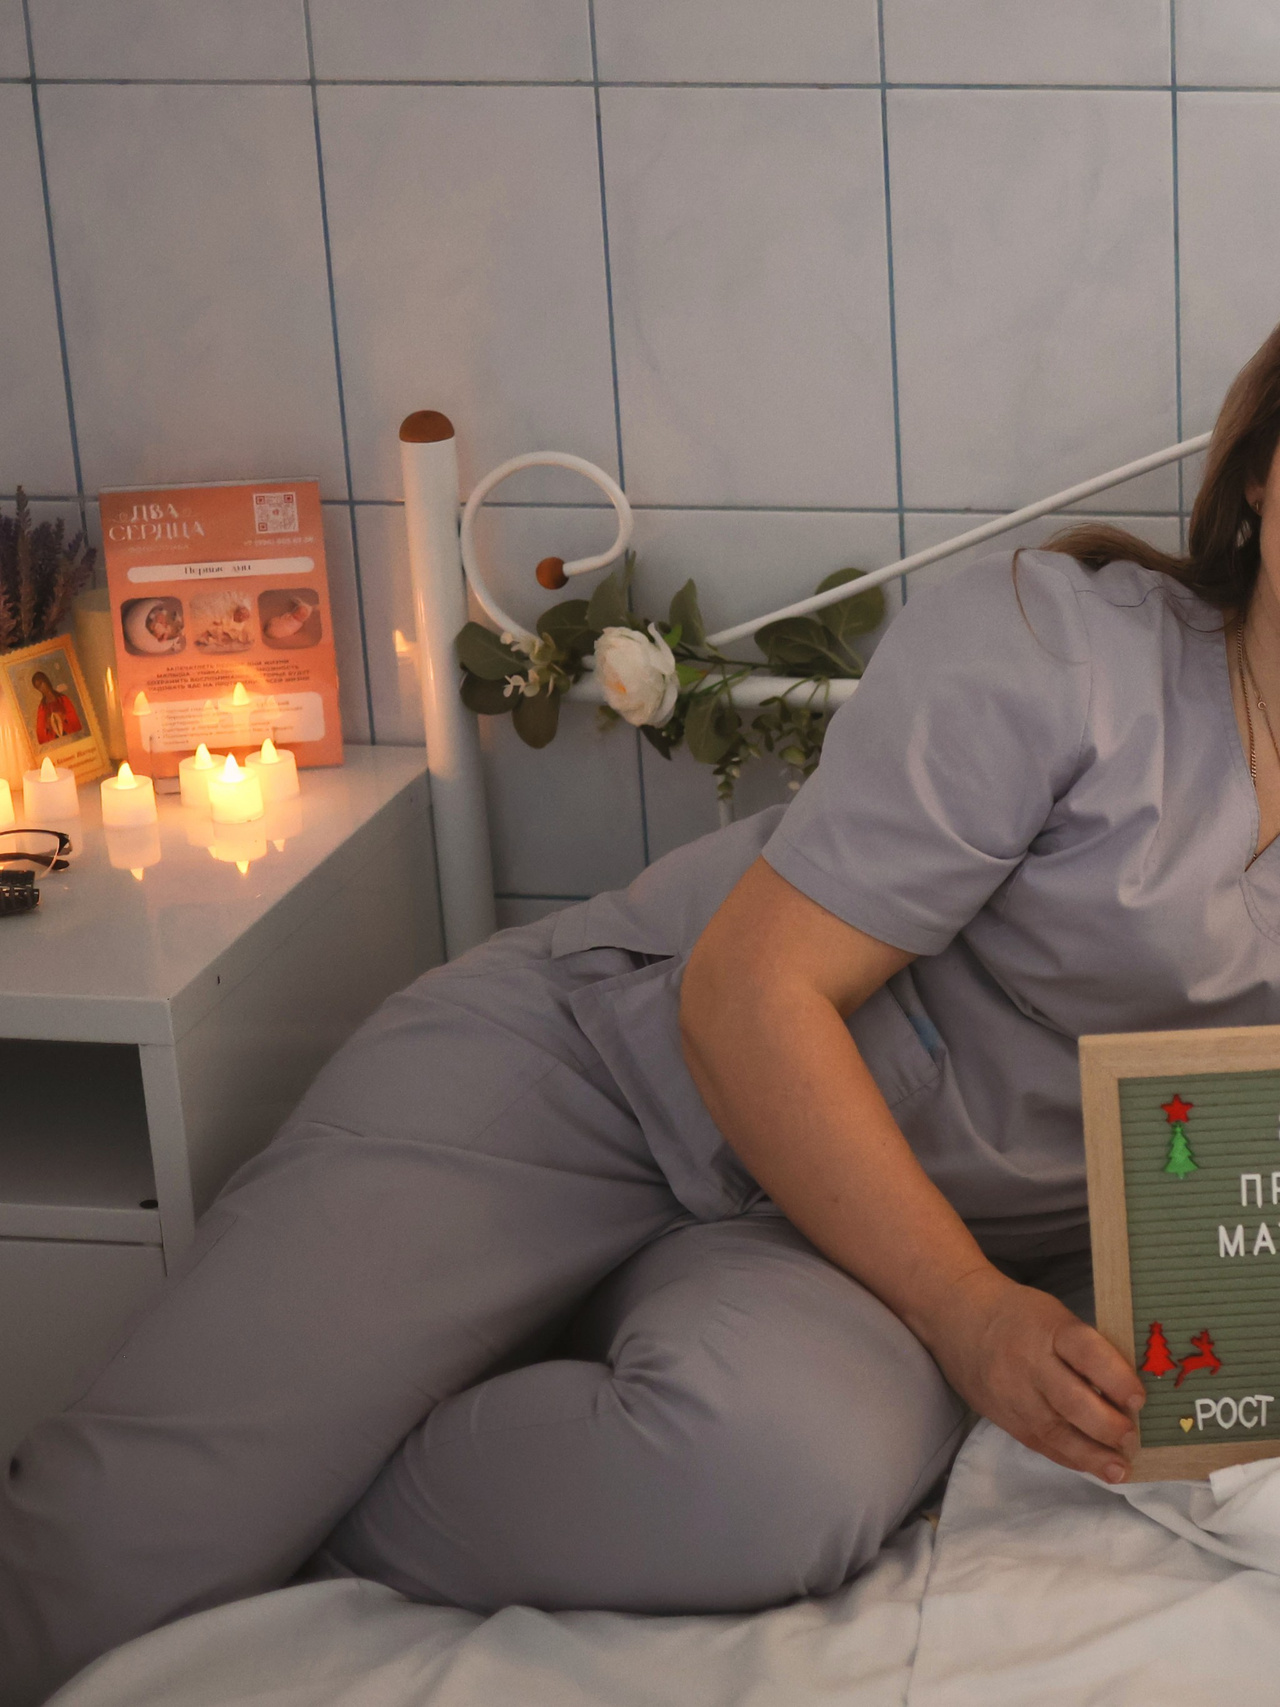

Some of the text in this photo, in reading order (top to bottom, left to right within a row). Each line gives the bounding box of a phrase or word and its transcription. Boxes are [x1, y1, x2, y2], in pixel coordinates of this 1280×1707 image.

[131, 503, 179, 522] ДВА
[108, 521, 205, 541] СЕРДЦА
[1195, 1394, 1275, 1431] РОСТ
